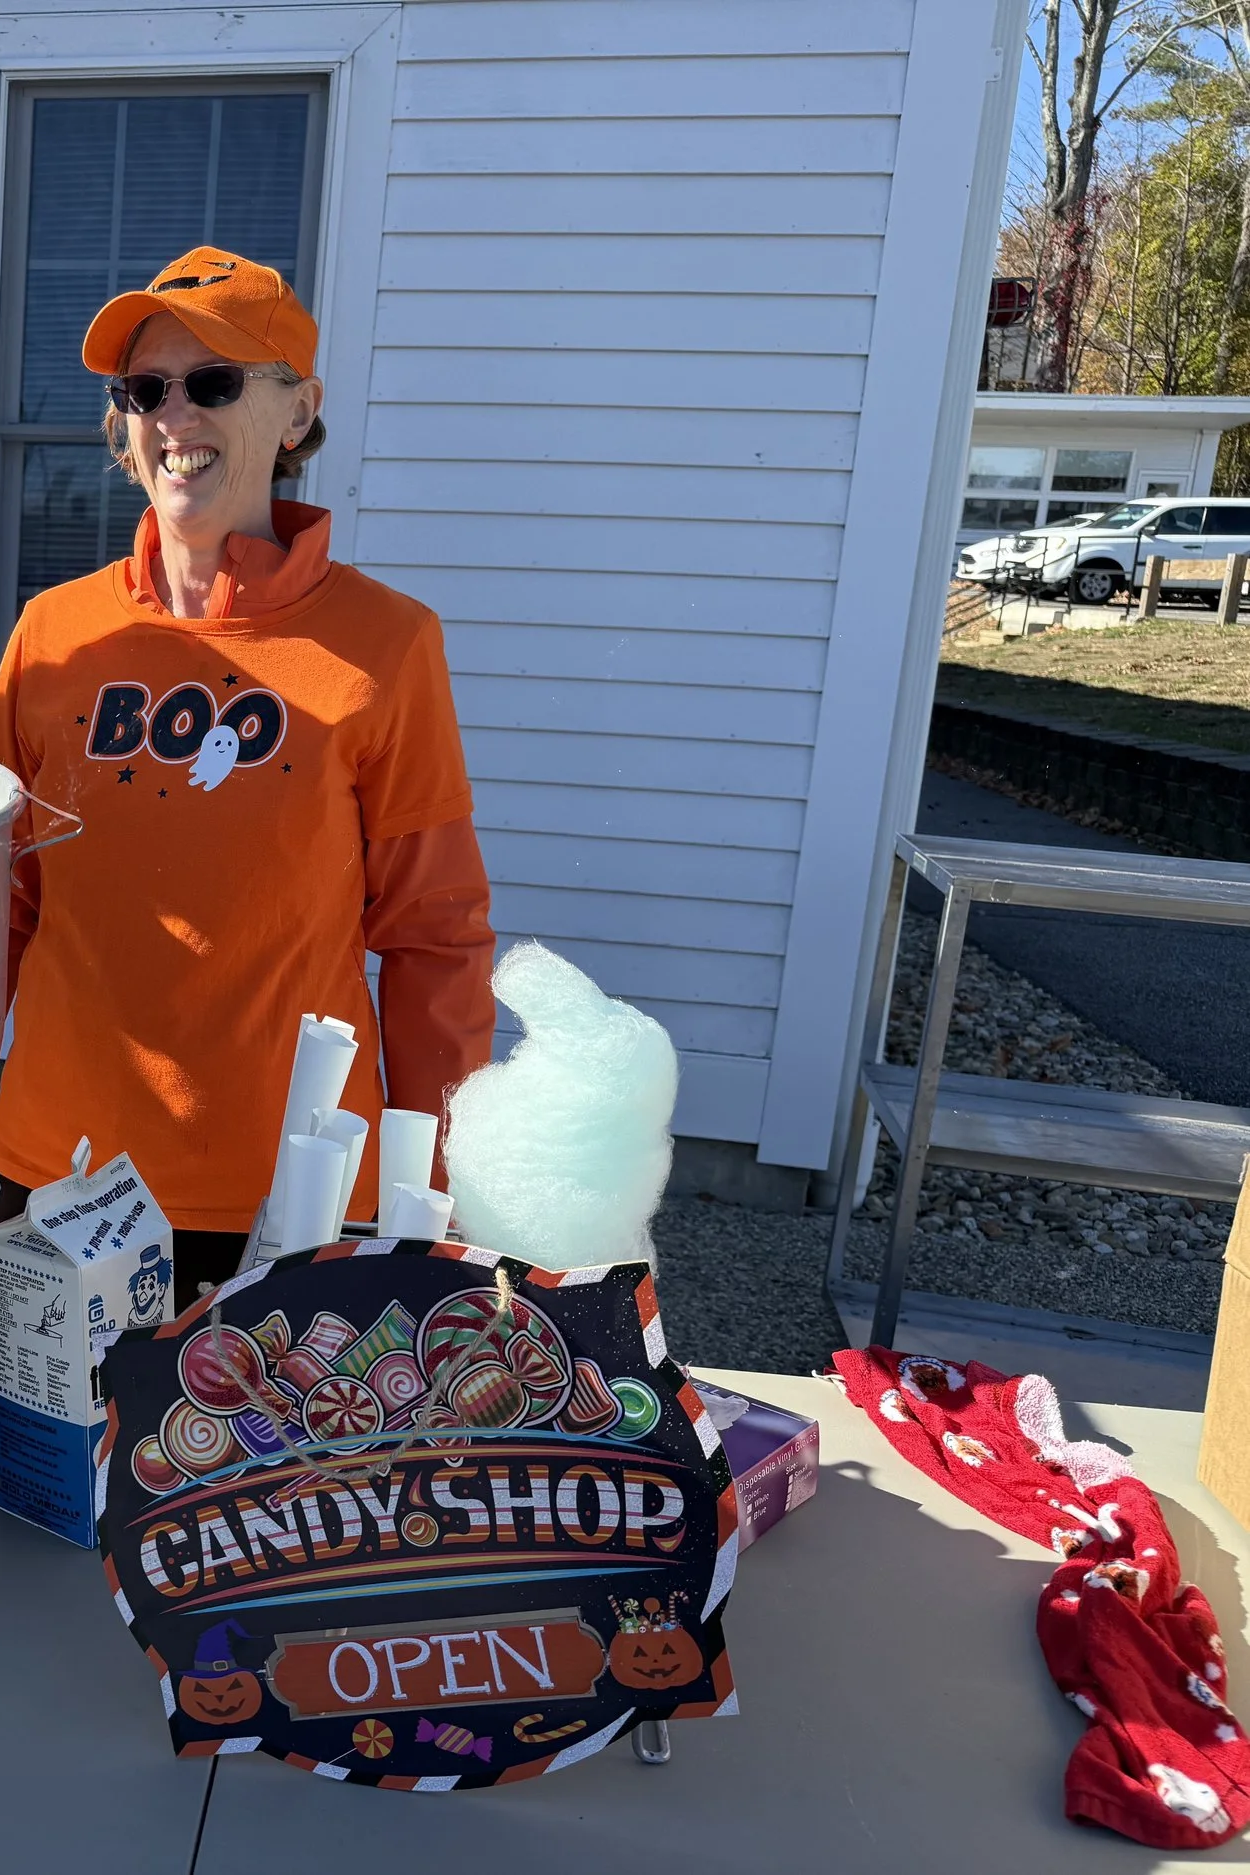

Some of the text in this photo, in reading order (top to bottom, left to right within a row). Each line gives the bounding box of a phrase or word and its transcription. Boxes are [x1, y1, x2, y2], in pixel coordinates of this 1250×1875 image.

[86, 681, 288, 768] BOO
[41, 1217, 63, 1230] One
[59, 1209, 81, 1221] step
[73, 1200, 99, 1216] floss
[94, 1176, 138, 1209] operation
[117, 1200, 147, 1239] ready-to-use
[24, 1234, 48, 1248] Tetra
[88, 1218, 114, 1252] pre-mixed
[89, 1318, 117, 1339] GOLD
[738, 1461, 776, 1494] Disposable
[776, 1446, 794, 1466] Vinyl
[794, 1431, 817, 1453] Gloves
[743, 1486, 762, 1504] Color:
[753, 1506, 767, 1521] Blue
[139, 1462, 686, 1598] CANDY SHOP
[327, 1625, 556, 1704] OPEN
